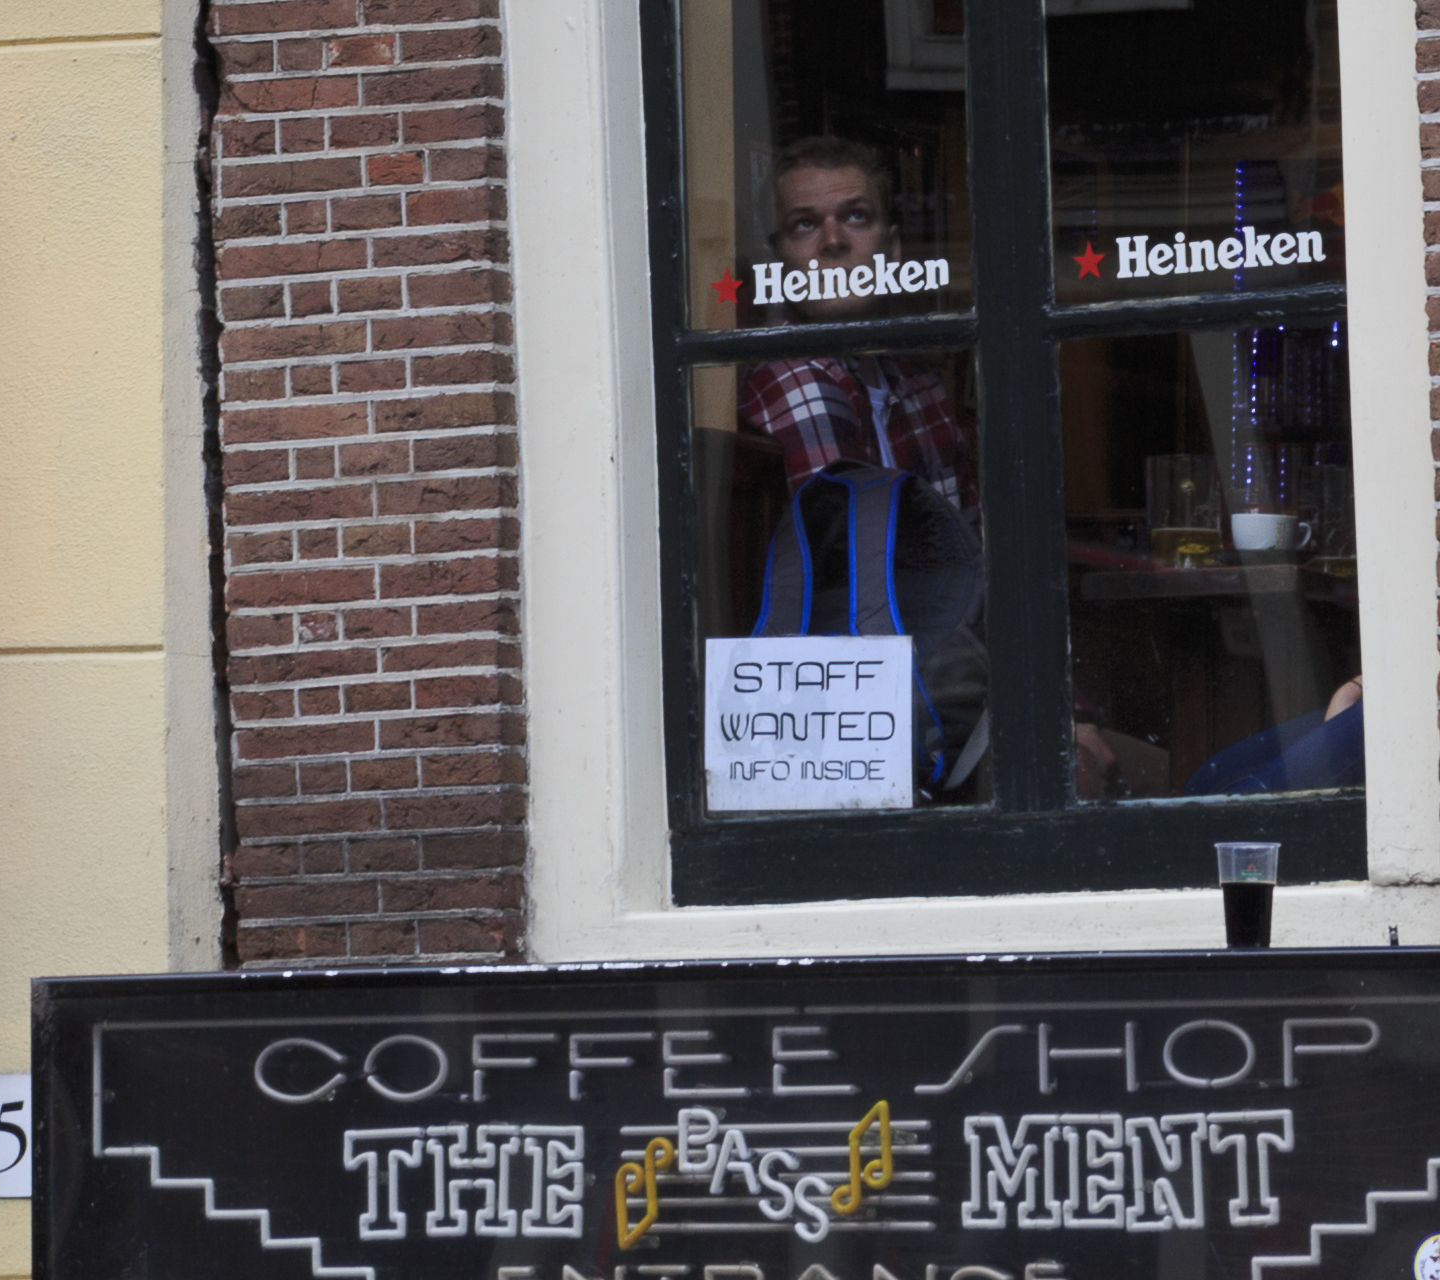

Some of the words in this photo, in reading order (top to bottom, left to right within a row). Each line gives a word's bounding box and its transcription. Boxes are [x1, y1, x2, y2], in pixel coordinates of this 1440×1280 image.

[752, 253, 950, 305] Heineken
[1116, 226, 1326, 280] Heineken
[733, 659, 884, 695] STAFF
[720, 709, 896, 743] WANTED
[728, 759, 792, 783] INFO
[800, 758, 886, 782] INSIDE
[255, 1024, 861, 1103] COFFEE
[915, 1017, 1380, 1094] SHOP
[344, 1124, 584, 1239] THE
[677, 1108, 833, 1243] BASS
[961, 1109, 1294, 1232] MENT
